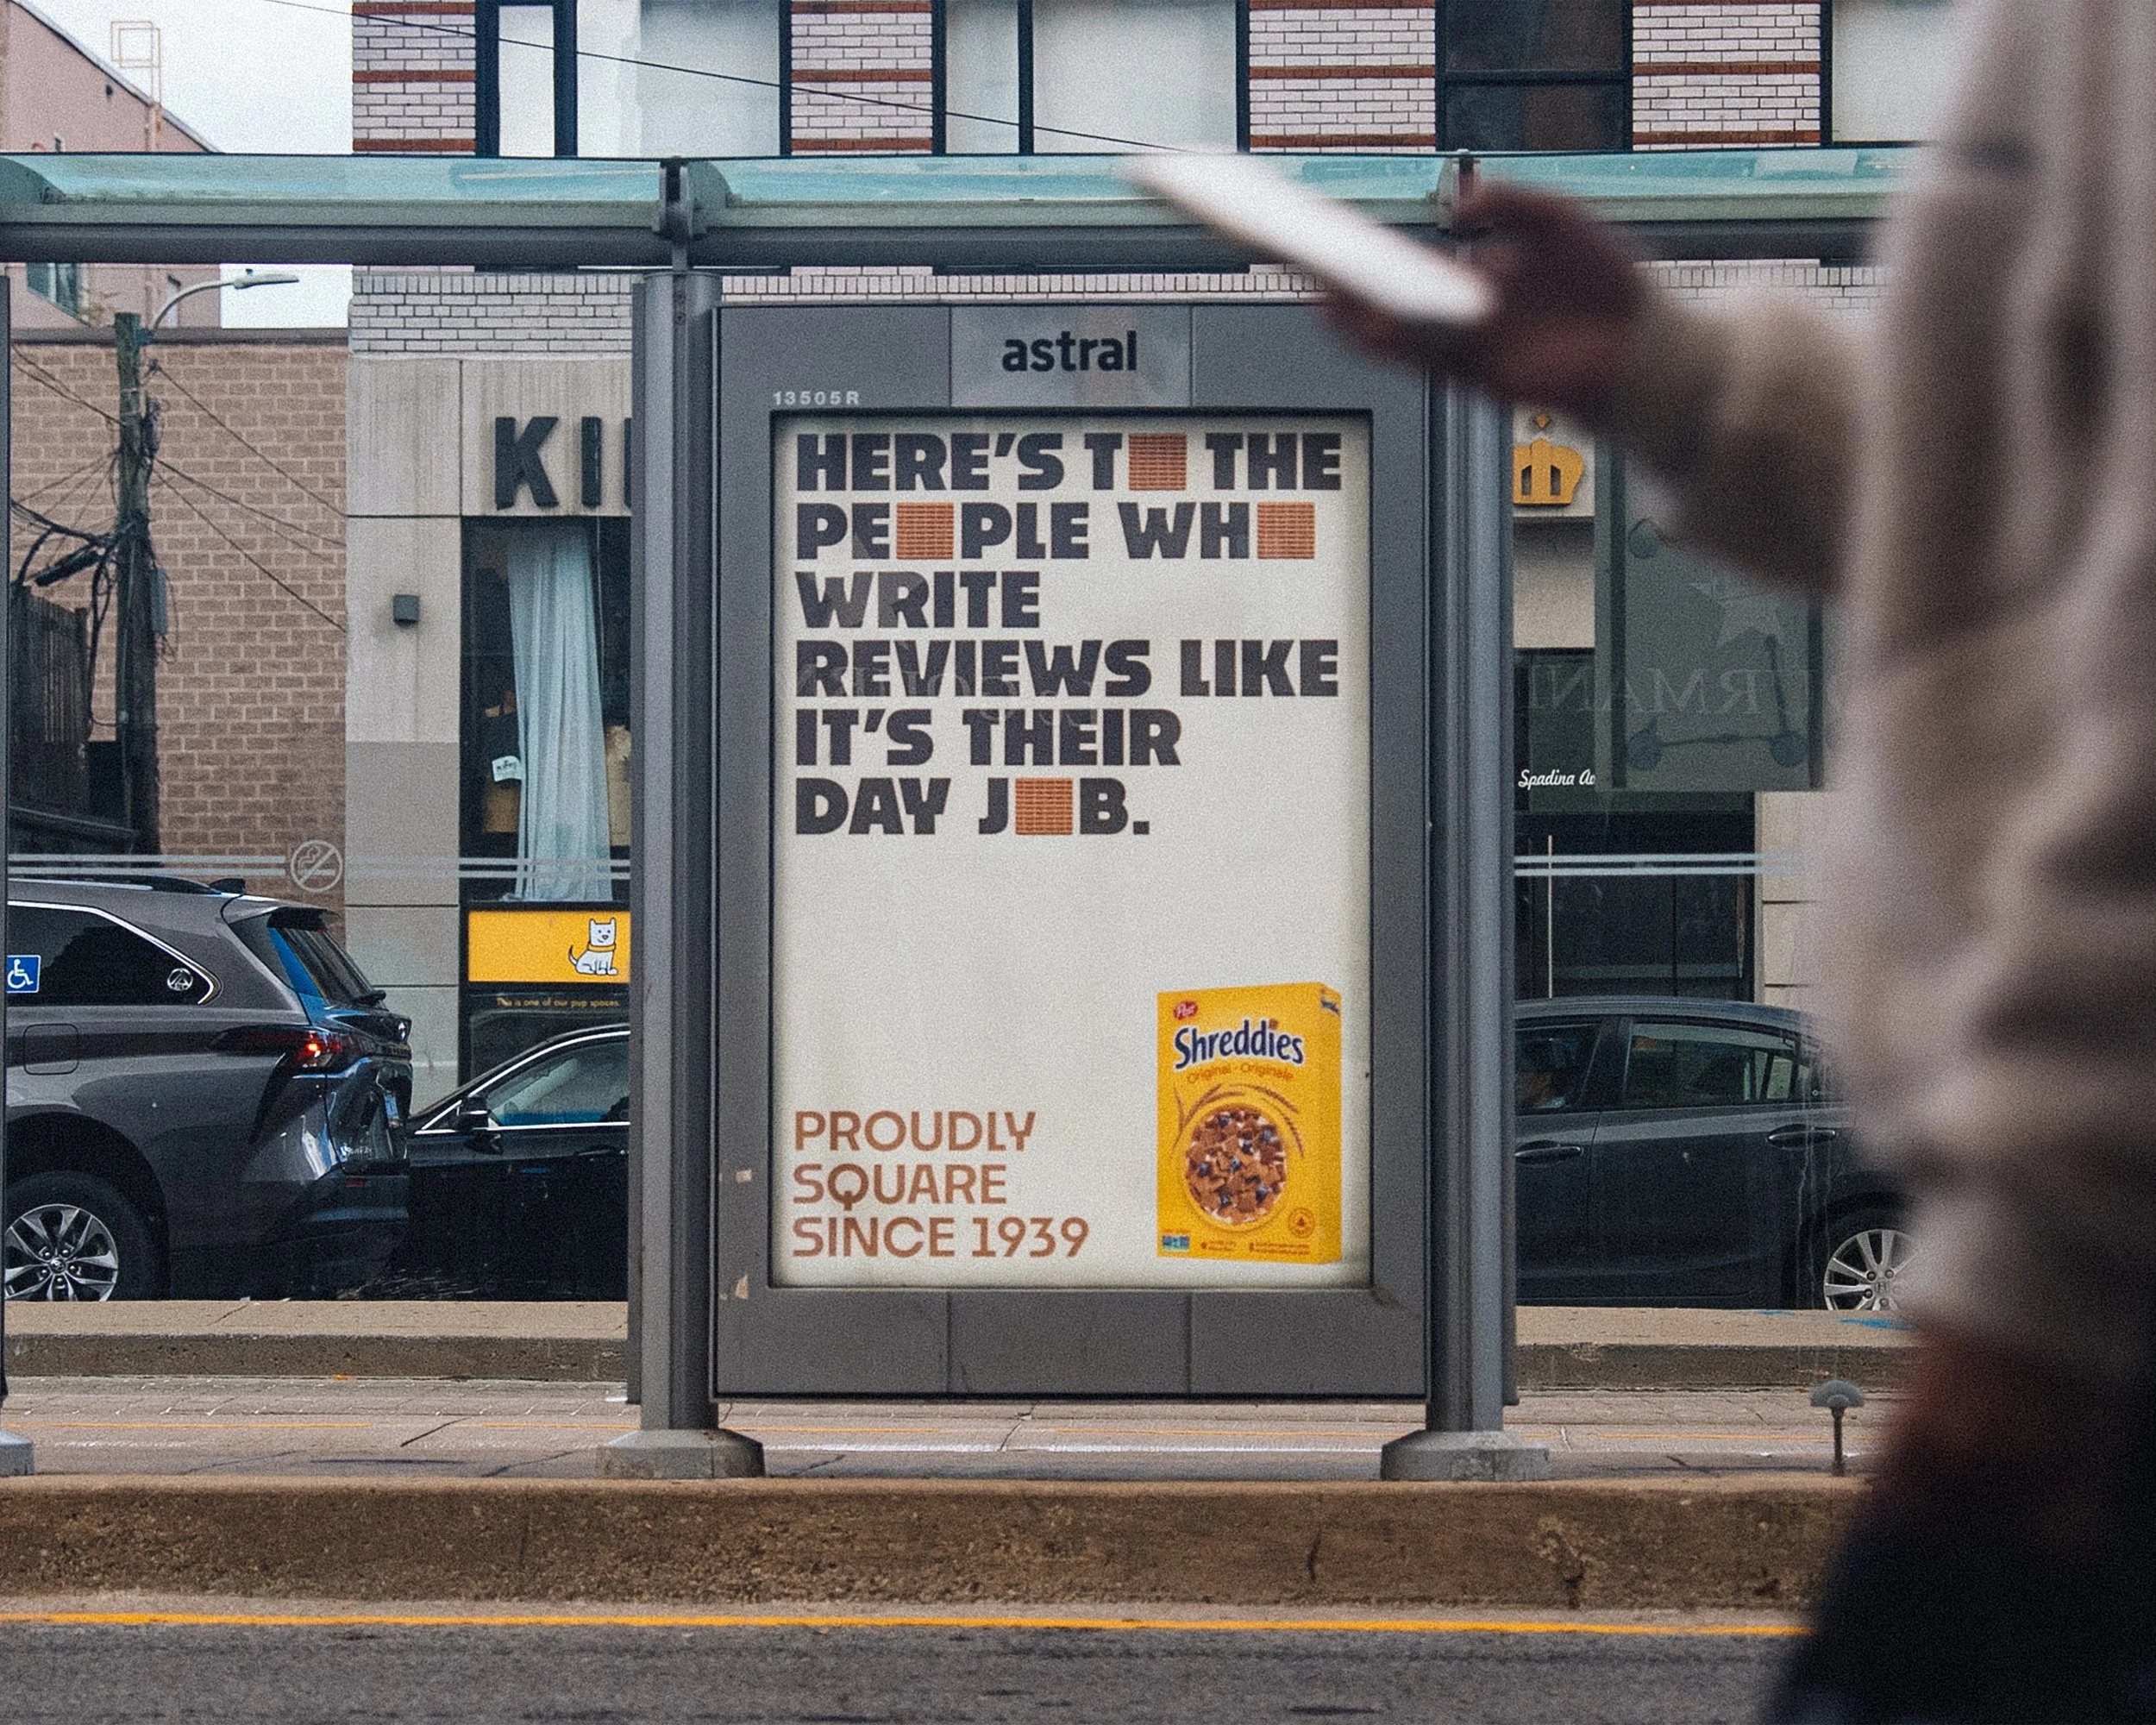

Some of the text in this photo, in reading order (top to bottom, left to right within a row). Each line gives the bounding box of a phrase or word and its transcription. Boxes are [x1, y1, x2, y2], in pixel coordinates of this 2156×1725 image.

[1003, 331, 1137, 371] astral
[774, 391, 859, 405] 13505R
[495, 417, 632, 509] KI
[796, 432, 1341, 491] HERE'S T THE
[796, 502, 1315, 560] PEPLE WH
[794, 570, 1040, 629] WRITE
[796, 639, 1152, 697] REVIEWS
[1180, 639, 1339, 697] LIKE
[796, 708, 1181, 766] IT'S THEIR
[1518, 768, 1576, 791] Spadina
[795, 777, 1150, 836] DAY JB.
[1175, 1003, 1196, 1019] Post
[1175, 1019, 1304, 1070] Shreddies
[1188, 1063, 1232, 1083] Original
[795, 1111, 1036, 1151] PROUDLY
[793, 1164, 1006, 1212] SQUARE
[793, 1216, 1089, 1258] SINCE 1939
